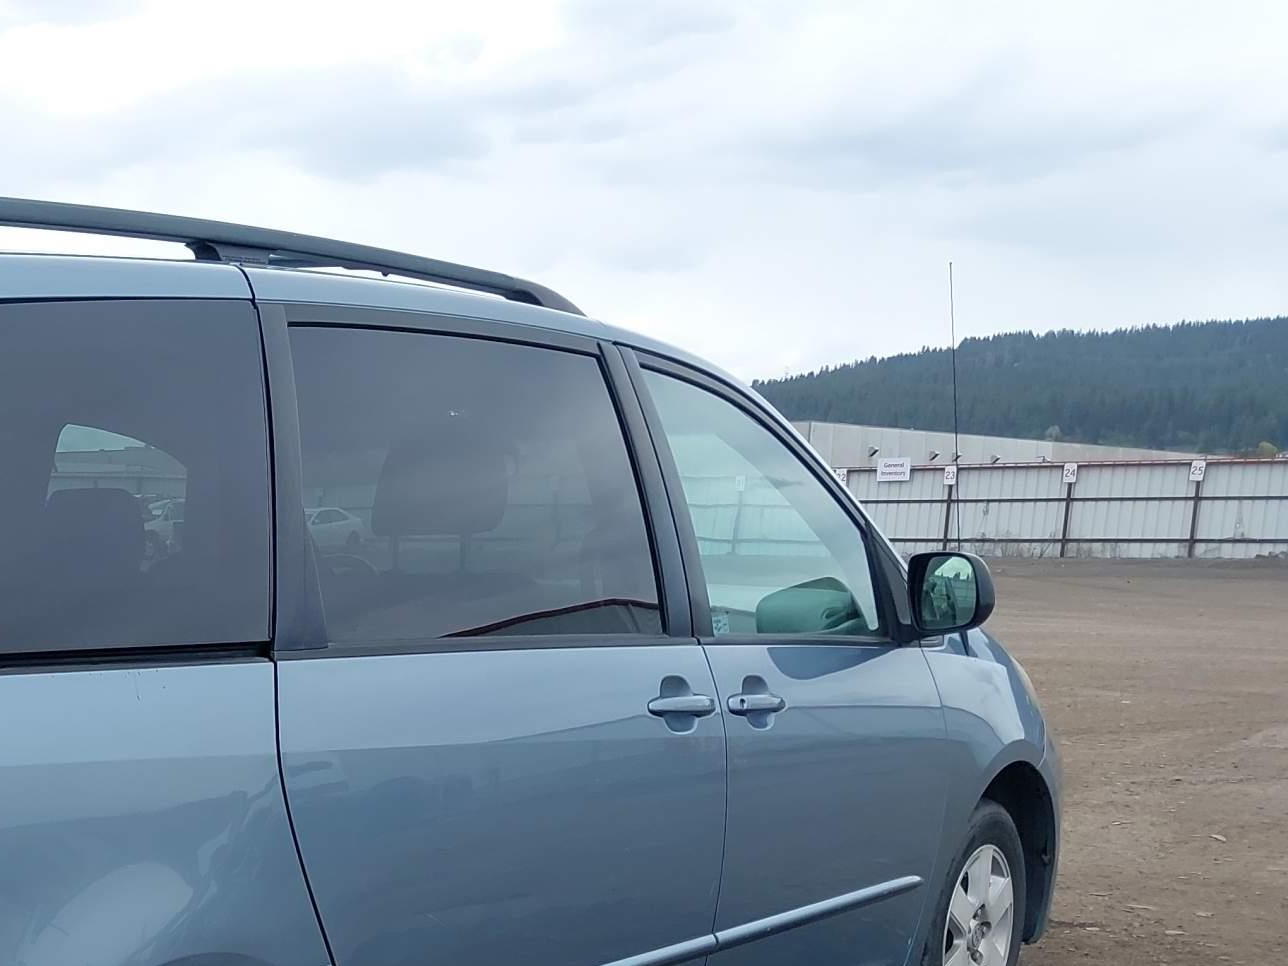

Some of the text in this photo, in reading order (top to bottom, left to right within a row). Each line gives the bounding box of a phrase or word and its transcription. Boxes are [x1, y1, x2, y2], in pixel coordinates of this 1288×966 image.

[945, 470, 956, 480] 23
[1064, 467, 1076, 478] 24
[1191, 465, 1204, 476] 25
